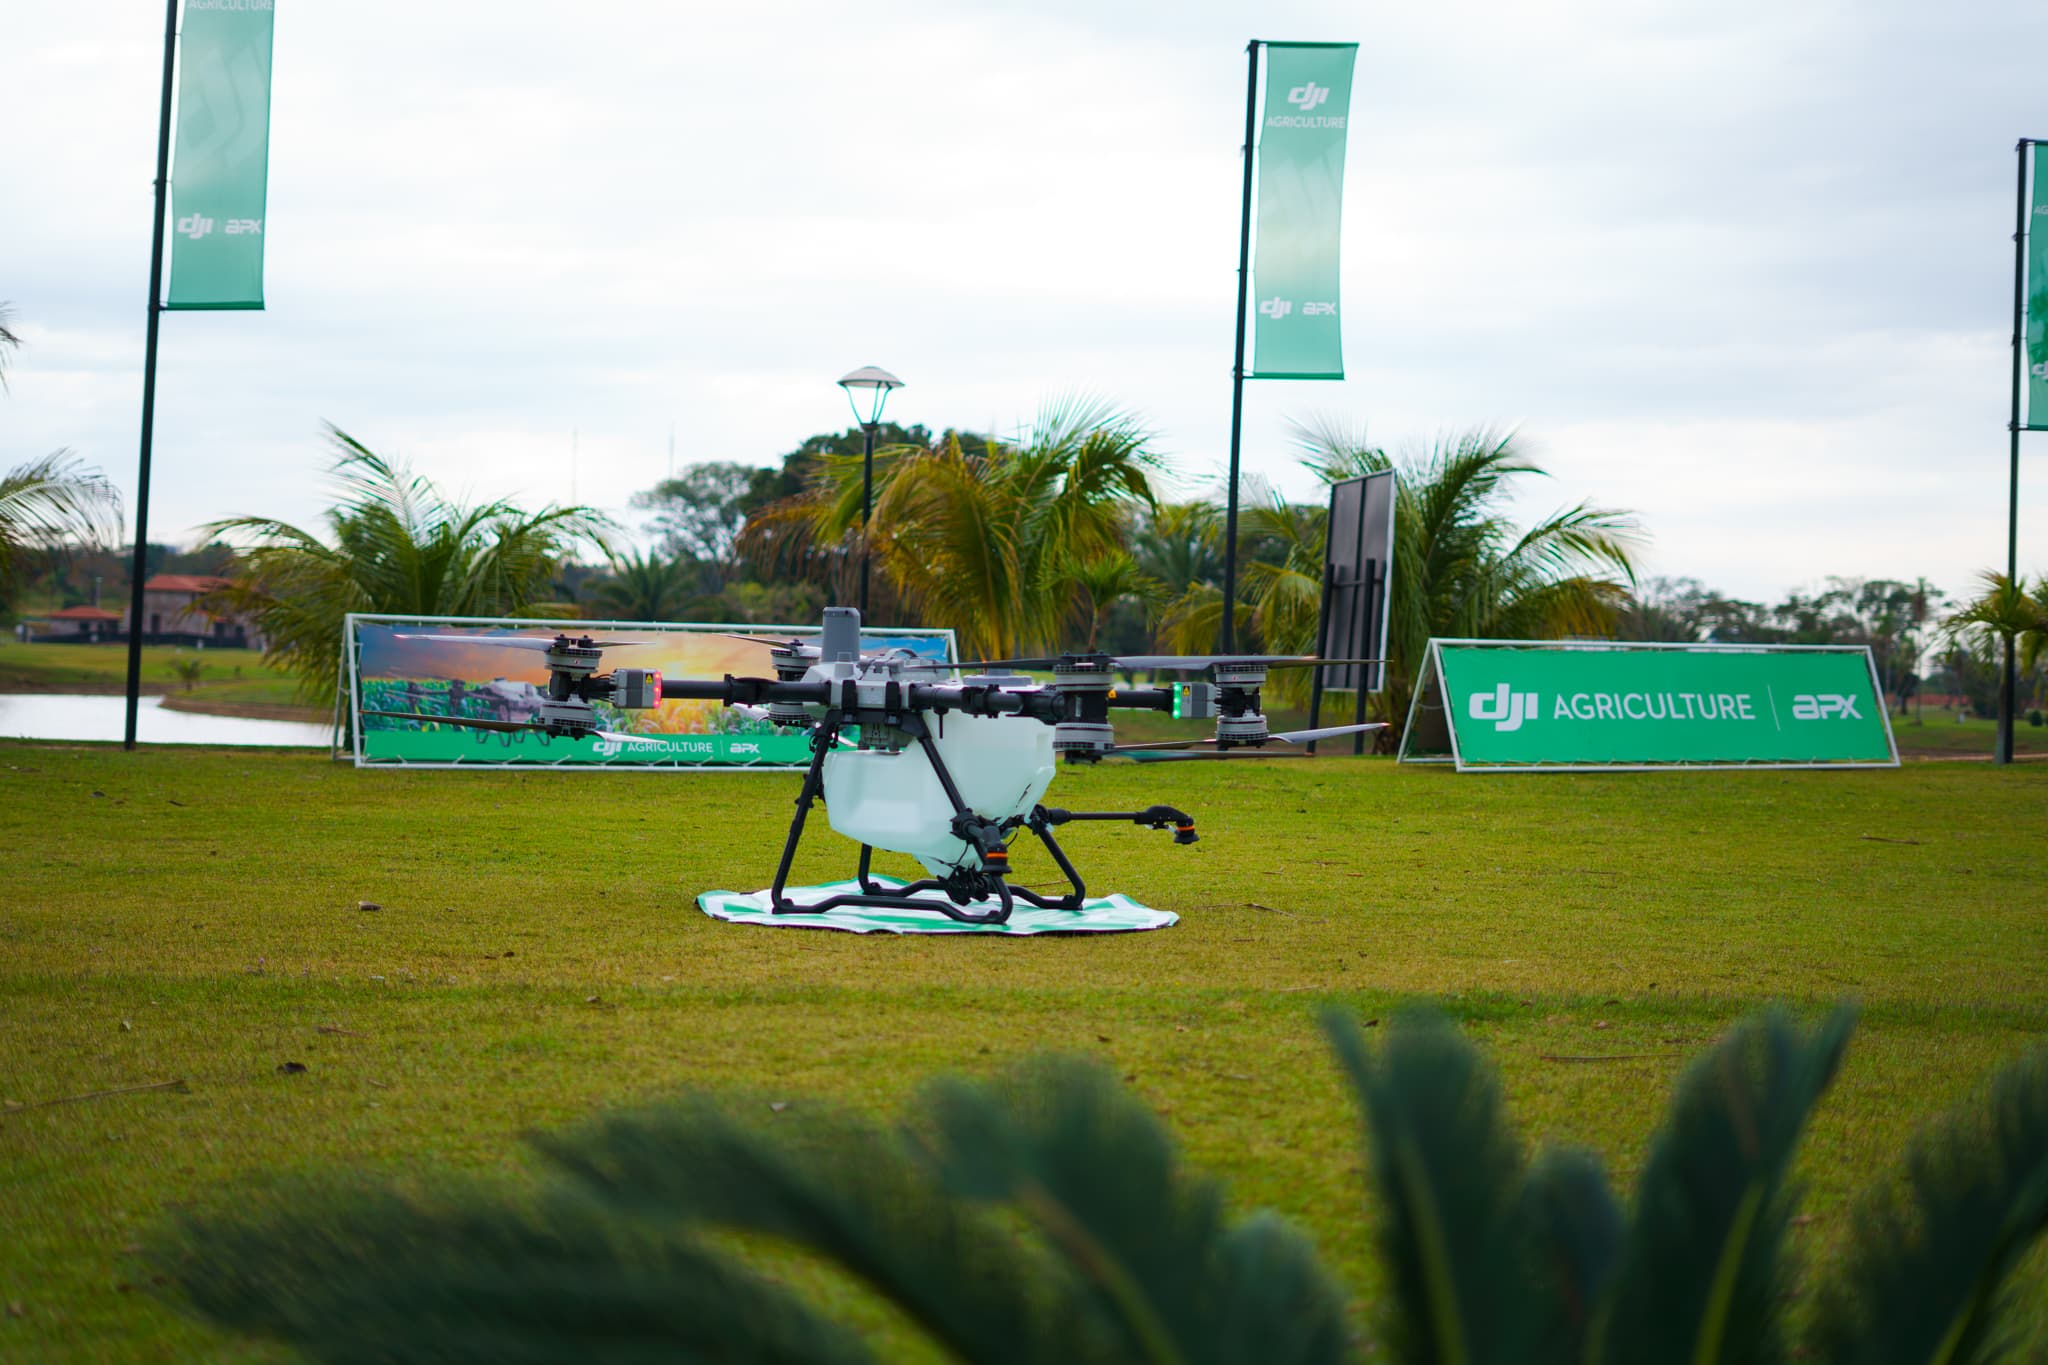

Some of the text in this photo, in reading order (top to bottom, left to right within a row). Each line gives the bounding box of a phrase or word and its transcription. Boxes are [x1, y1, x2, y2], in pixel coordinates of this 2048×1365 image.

[1266, 116, 1346, 128] AGRICULTURE
[1553, 692, 1756, 720] AGRICULTURE
[626, 740, 714, 754] AGRICULTURE
